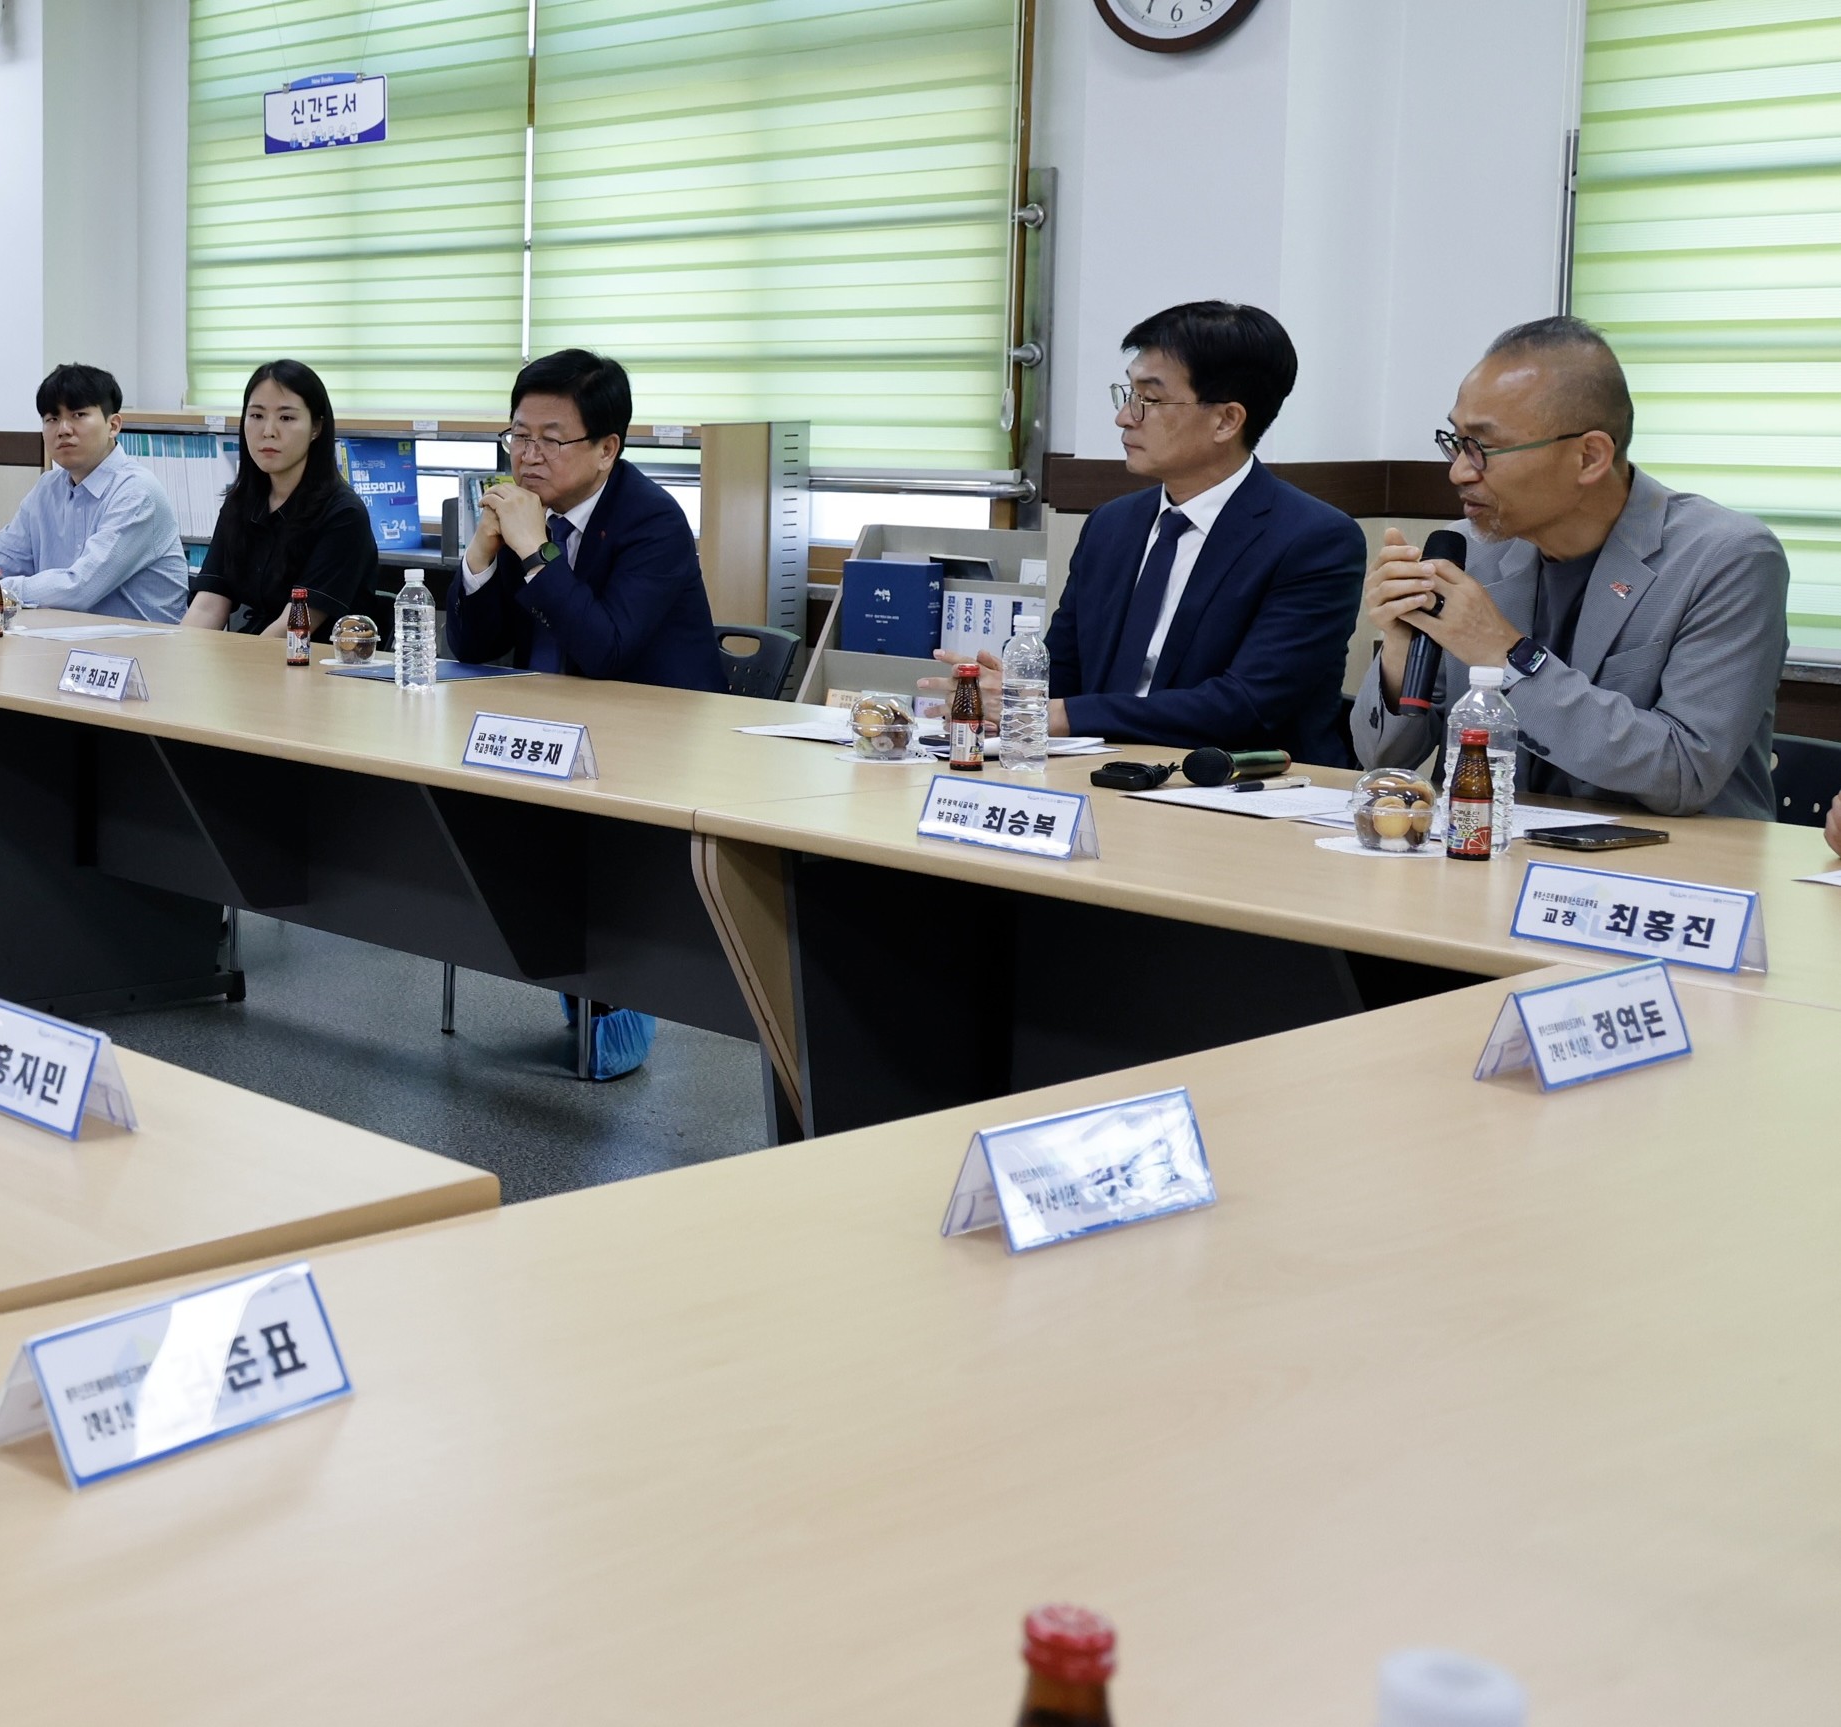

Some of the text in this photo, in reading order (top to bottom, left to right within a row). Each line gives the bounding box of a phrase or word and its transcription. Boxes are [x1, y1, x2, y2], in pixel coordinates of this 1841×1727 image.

[1170, 1, 1183, 22] 6
[291, 93, 357, 125] 신간도서
[353, 481, 406, 495] 하프모의고사
[360, 495, 373, 507] 어
[391, 519, 407, 531] 24
[86, 668, 119, 689] 최교진
[476, 732, 507, 744] 교육부
[510, 737, 563, 765] 장홍재
[982, 806, 1056, 838] 최승복
[1542, 907, 1577, 927] 교장
[1605, 903, 1715, 949] 최홍진
[1593, 1000, 1667, 1049] 정연돈
